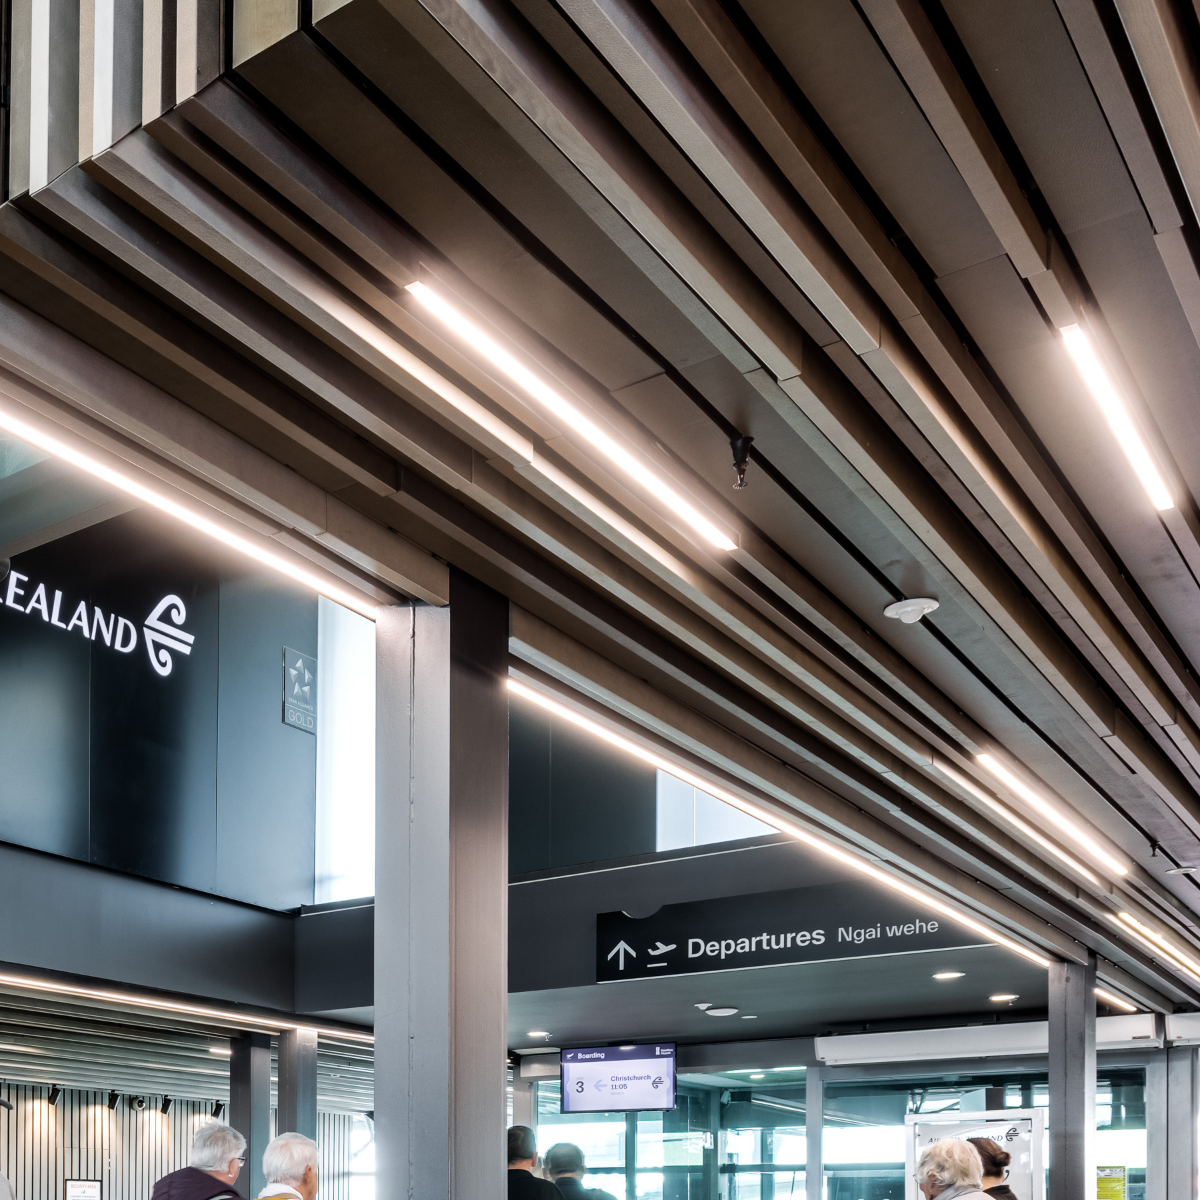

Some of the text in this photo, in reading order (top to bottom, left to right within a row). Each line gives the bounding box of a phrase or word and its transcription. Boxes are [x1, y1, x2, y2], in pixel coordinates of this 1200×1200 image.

[288, 709, 314, 729] GOLD
[687, 918, 940, 960] Departures Ngai wehe
[577, 1051, 605, 1060] Boarding
[610, 1074, 652, 1082] Christchurch
[575, 1080, 585, 1094] 3
[610, 1083, 628, 1091] 11:05
